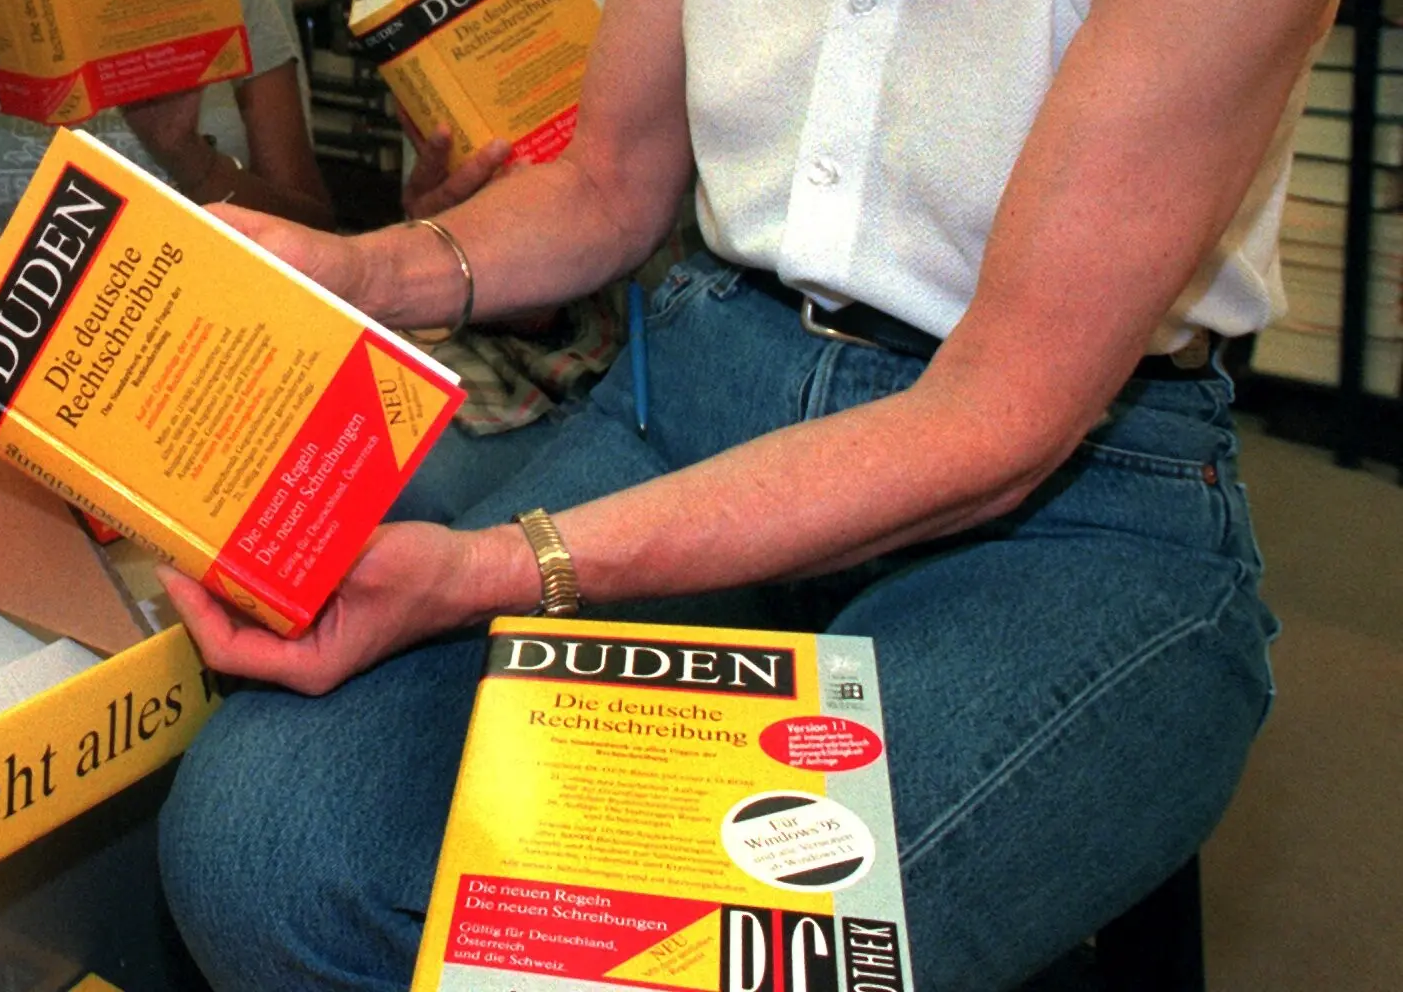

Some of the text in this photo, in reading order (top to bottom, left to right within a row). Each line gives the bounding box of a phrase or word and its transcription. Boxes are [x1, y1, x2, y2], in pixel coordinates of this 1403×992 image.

[454, 18, 482, 42] Die
[43, 246, 142, 394] Die deutsche
[55, 241, 184, 429] Rechtschreibung
[237, 441, 320, 555] Die neuen Regeln
[255, 413, 366, 566] Die neuen Schreibungen
[504, 638, 781, 690] DUDEN
[553, 693, 723, 723] Die deutsche
[75, 684, 183, 779] alles
[529, 710, 748, 747] Rechtschreibung
[787, 723, 829, 733] Version
[744, 826, 817, 850] Windows
[769, 818, 799, 831] Für
[468, 880, 611, 908] Die neuen Regeln
[466, 897, 668, 931] Die neuen Schreibungen
[457, 933, 525, 952] Österreich
[460, 922, 524, 938] Gültig für
[454, 950, 505, 963] und die
[648, 934, 688, 962] NEU
